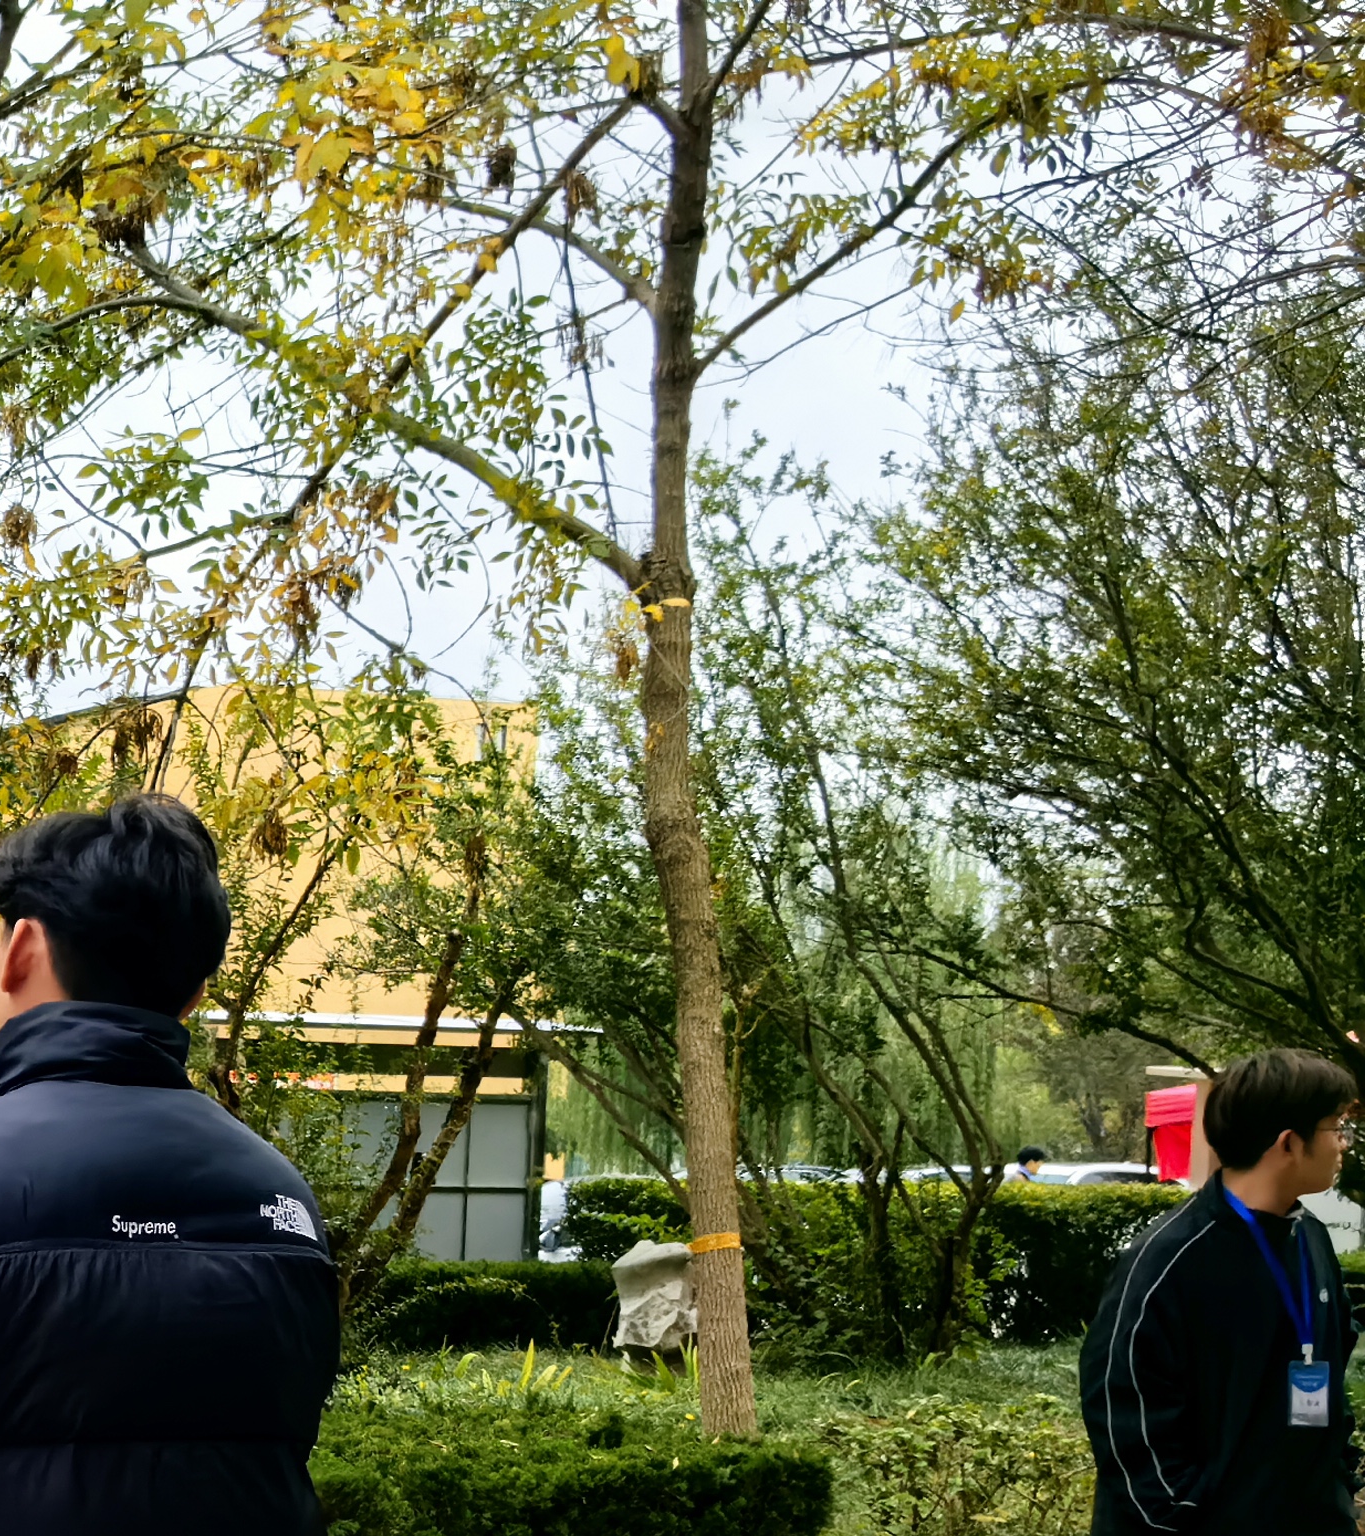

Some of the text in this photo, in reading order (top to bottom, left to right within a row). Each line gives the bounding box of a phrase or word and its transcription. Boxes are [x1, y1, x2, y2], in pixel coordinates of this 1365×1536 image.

[275, 1194, 297, 1210] THE
[260, 1204, 297, 1222] NORTH
[112, 1215, 176, 1238] Supreme
[273, 1218, 303, 1233] FACE
